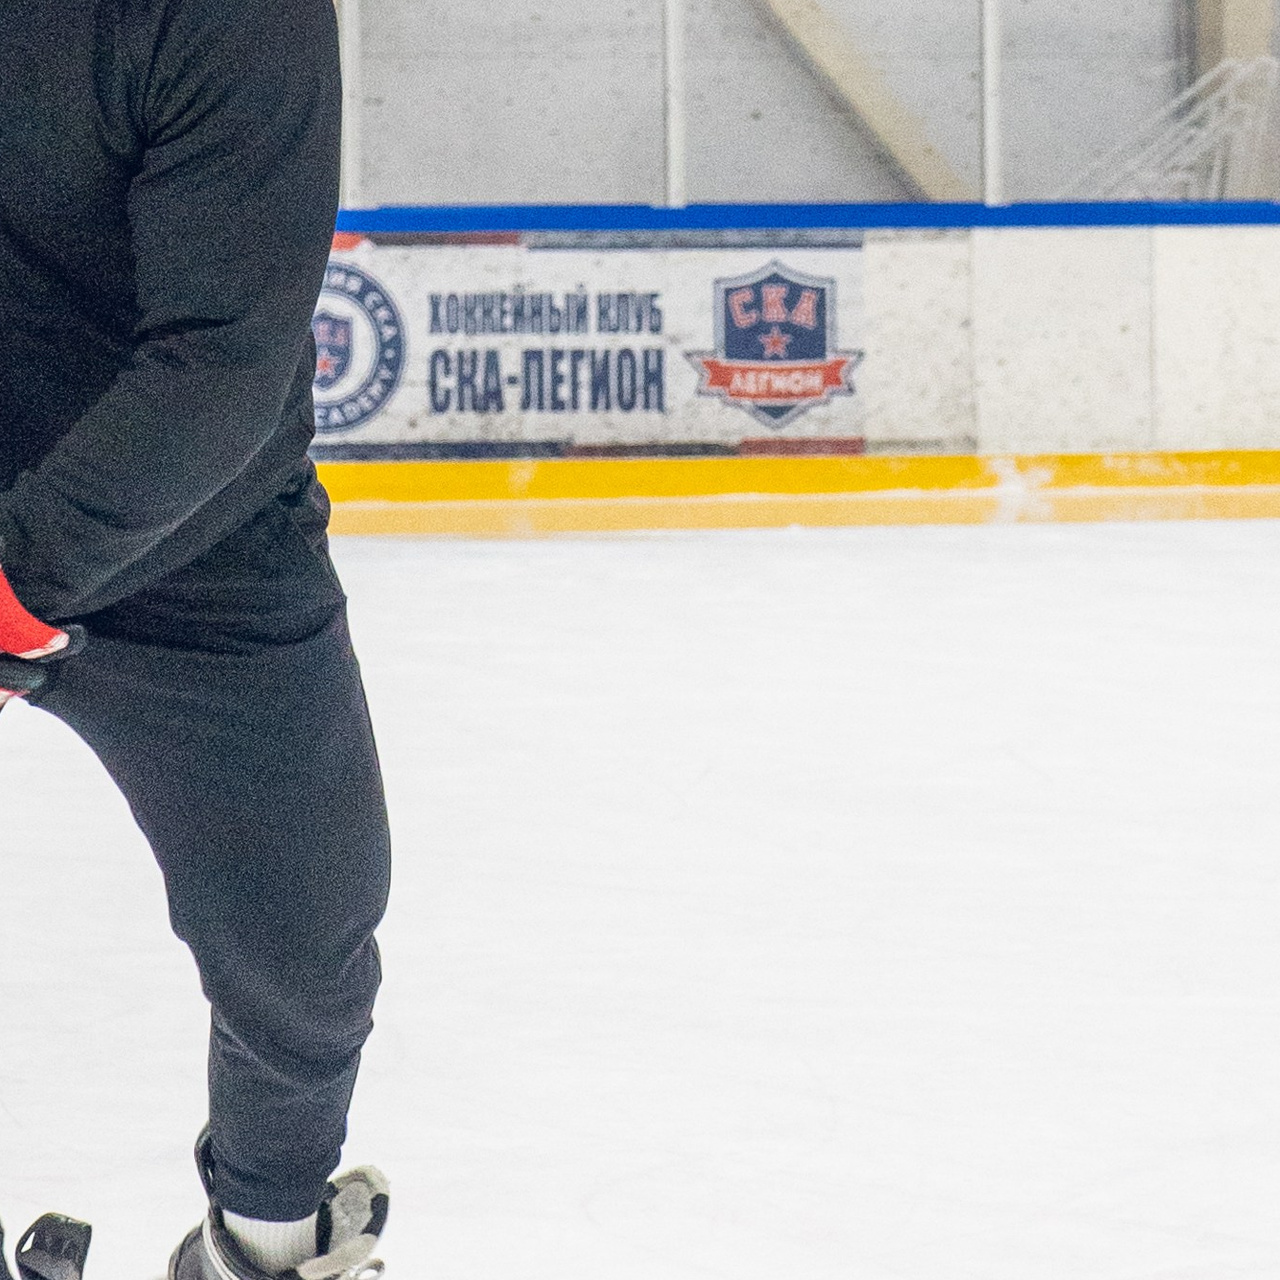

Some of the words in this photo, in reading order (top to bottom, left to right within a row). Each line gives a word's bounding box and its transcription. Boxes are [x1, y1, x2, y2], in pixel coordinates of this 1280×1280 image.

[427, 283, 588, 335] ХОККЕЙНЫЙ
[596, 292, 663, 335] КЛУБ
[727, 284, 818, 330] СКА
[428, 348, 667, 413] СКА-ЛЕГИОН
